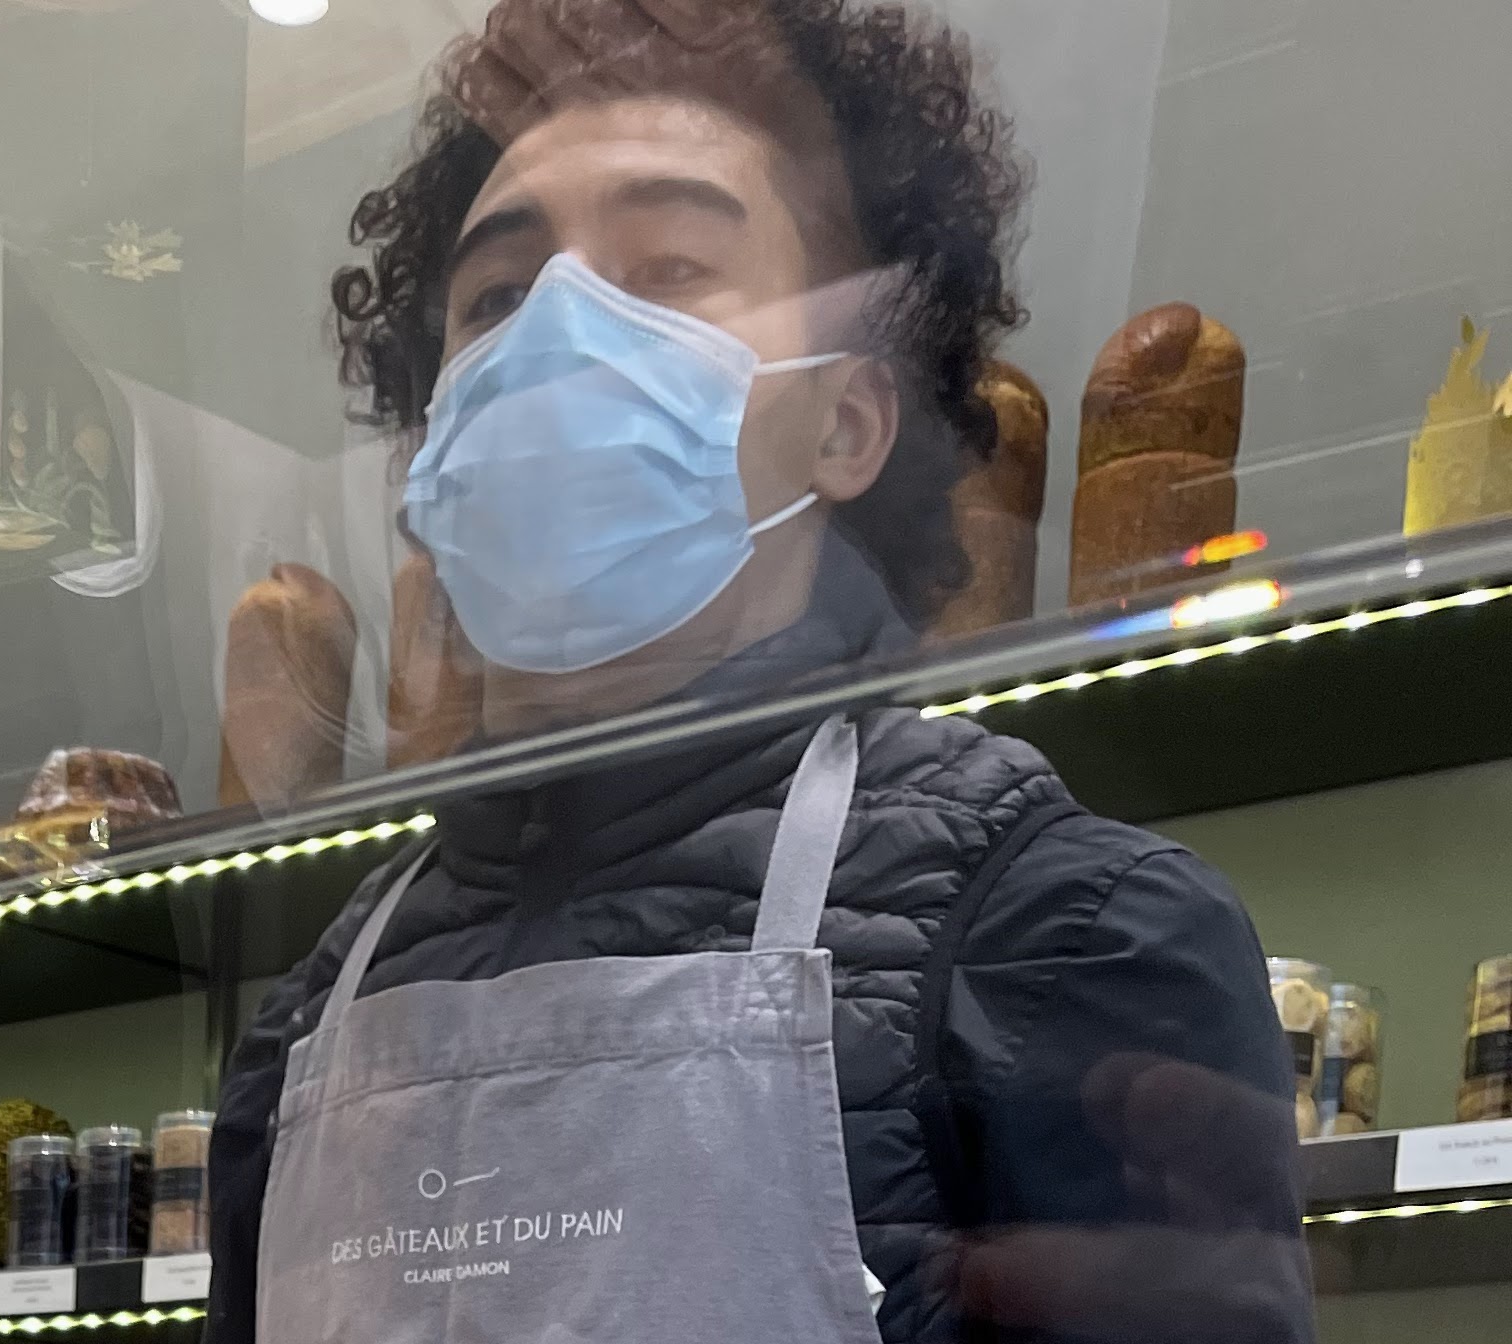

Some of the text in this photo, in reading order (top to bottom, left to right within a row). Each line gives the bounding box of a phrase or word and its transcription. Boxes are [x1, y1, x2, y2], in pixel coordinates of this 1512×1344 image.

[331, 1207, 624, 1264] DES GÂTEAUX ET DU PAIN
[403, 1259, 510, 1284] CLAIRE DAMON
